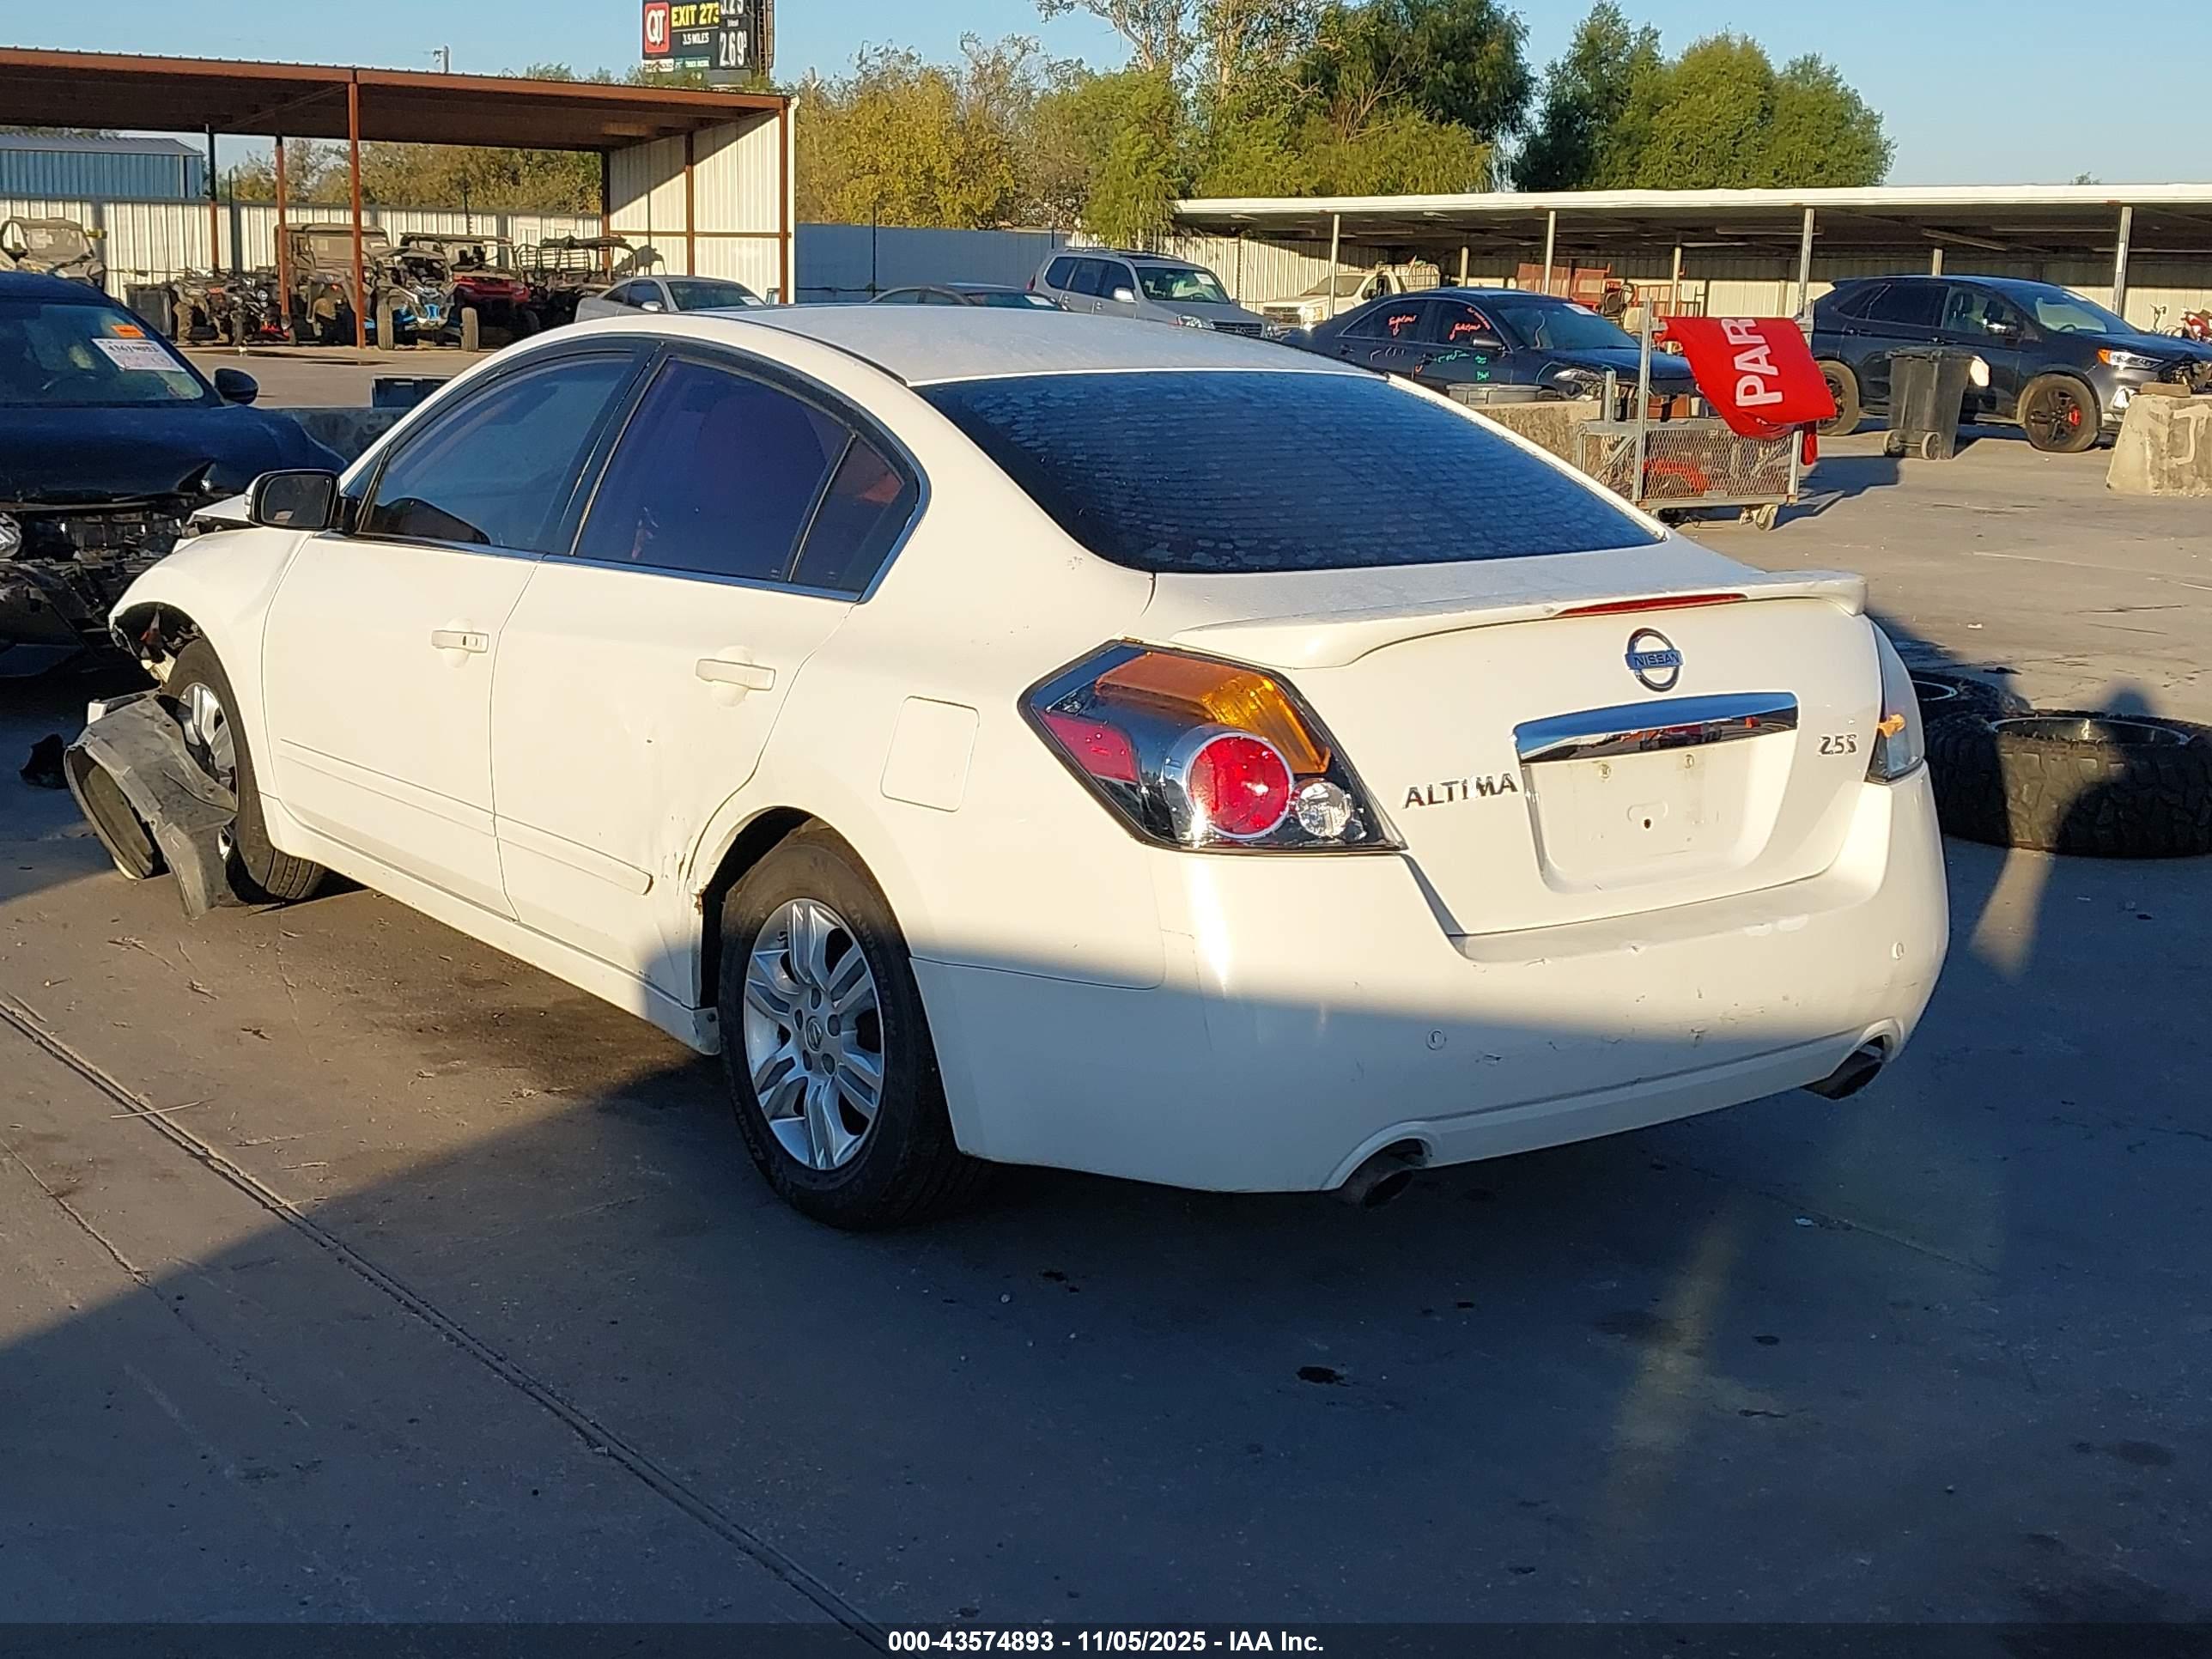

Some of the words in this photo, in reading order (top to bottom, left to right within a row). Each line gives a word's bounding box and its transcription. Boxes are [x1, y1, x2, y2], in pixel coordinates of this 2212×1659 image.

[646, 9, 665, 46] QT
[672, 4, 697, 27] EXIT
[692, 32, 709, 44] MILES
[1721, 319, 1783, 406] PAR
[1634, 653, 1680, 666] NISSAN
[1402, 773, 1518, 809] ALTIMA
